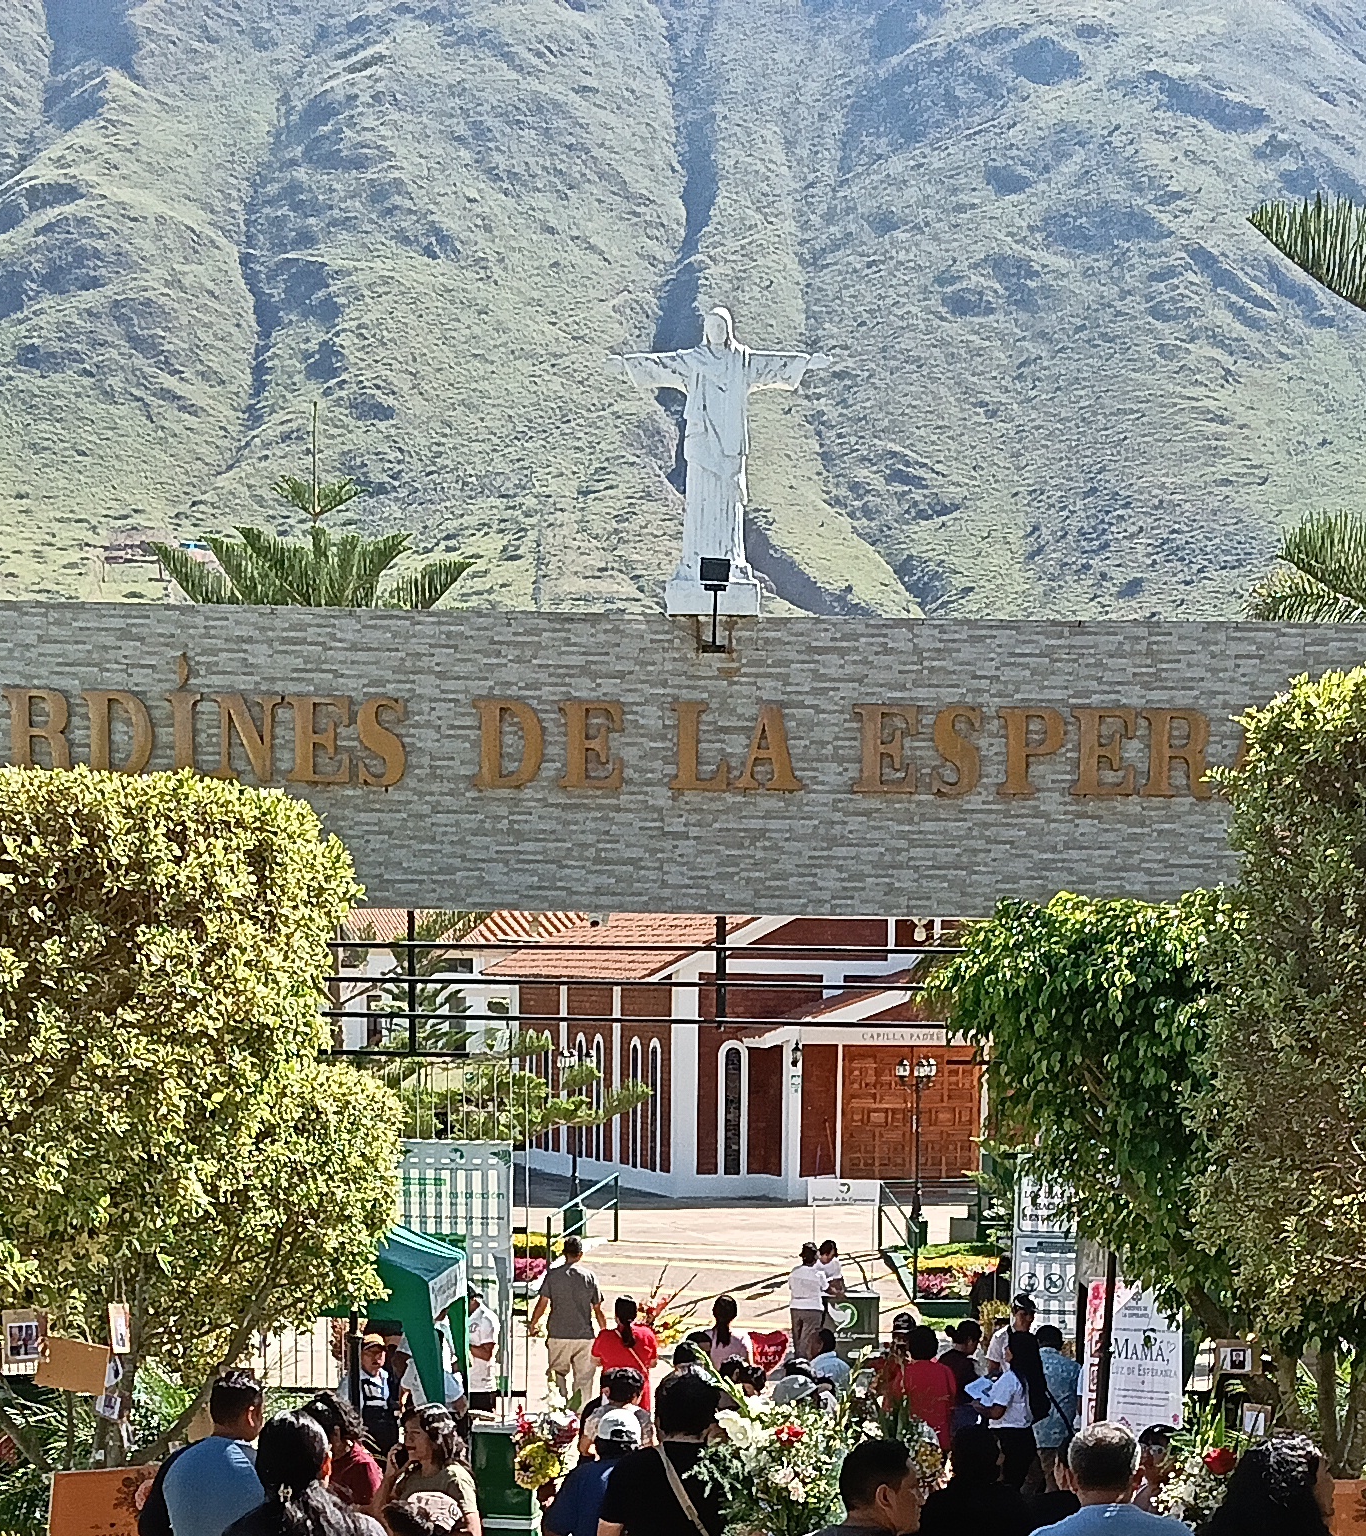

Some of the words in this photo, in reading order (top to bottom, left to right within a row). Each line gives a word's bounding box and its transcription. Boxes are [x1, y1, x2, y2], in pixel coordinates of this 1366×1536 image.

[472, 697, 626, 791] DE
[668, 700, 804, 792] LA
[852, 703, 1248, 799] ESPER
[861, 1032, 905, 1042] CAPILLA
